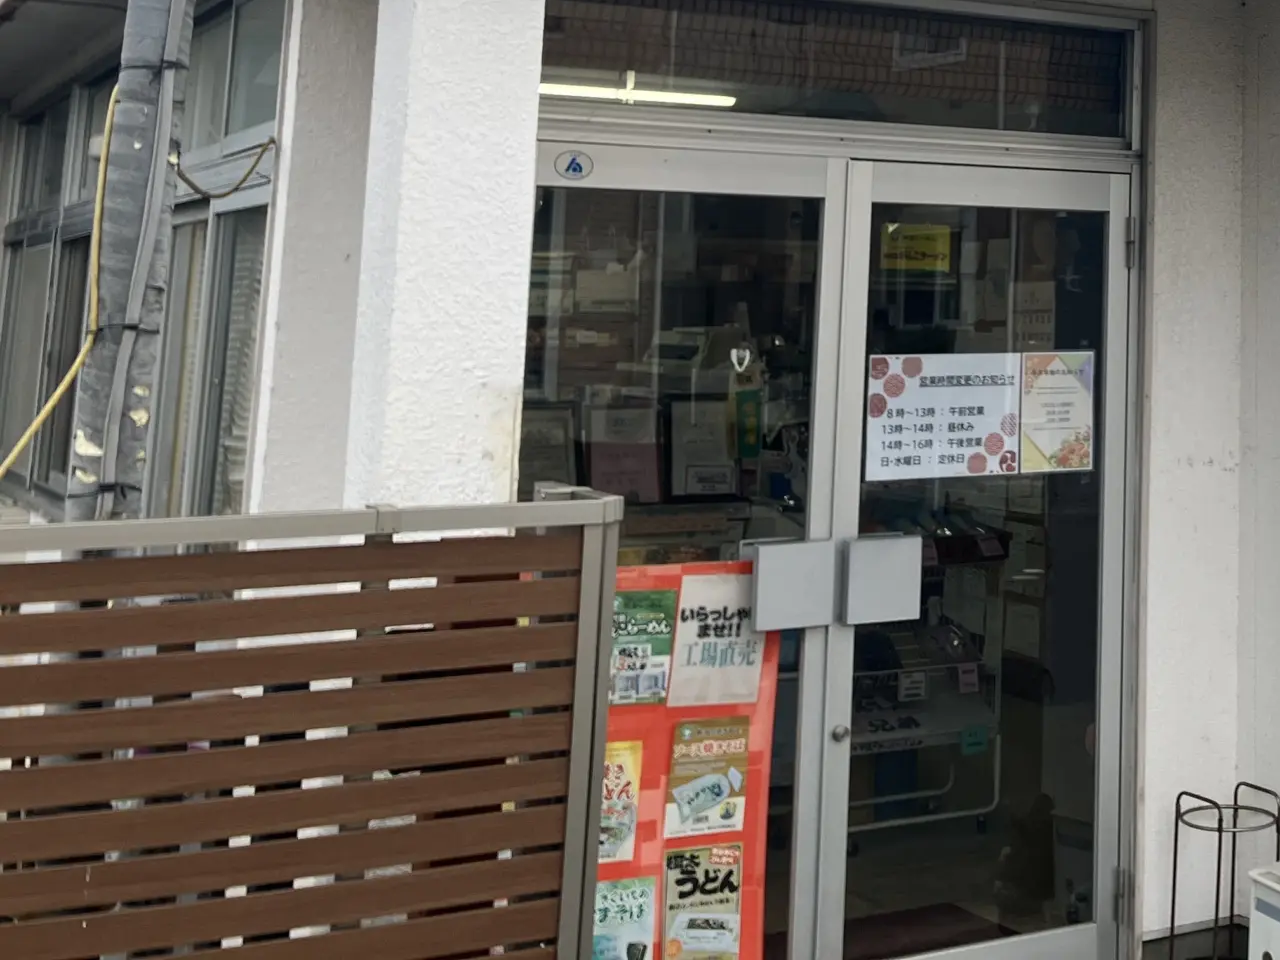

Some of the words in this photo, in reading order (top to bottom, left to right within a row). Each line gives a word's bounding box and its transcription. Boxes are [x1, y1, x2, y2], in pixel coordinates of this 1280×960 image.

[681, 641, 758, 668] 工場直売
[675, 867, 740, 899] うどん
